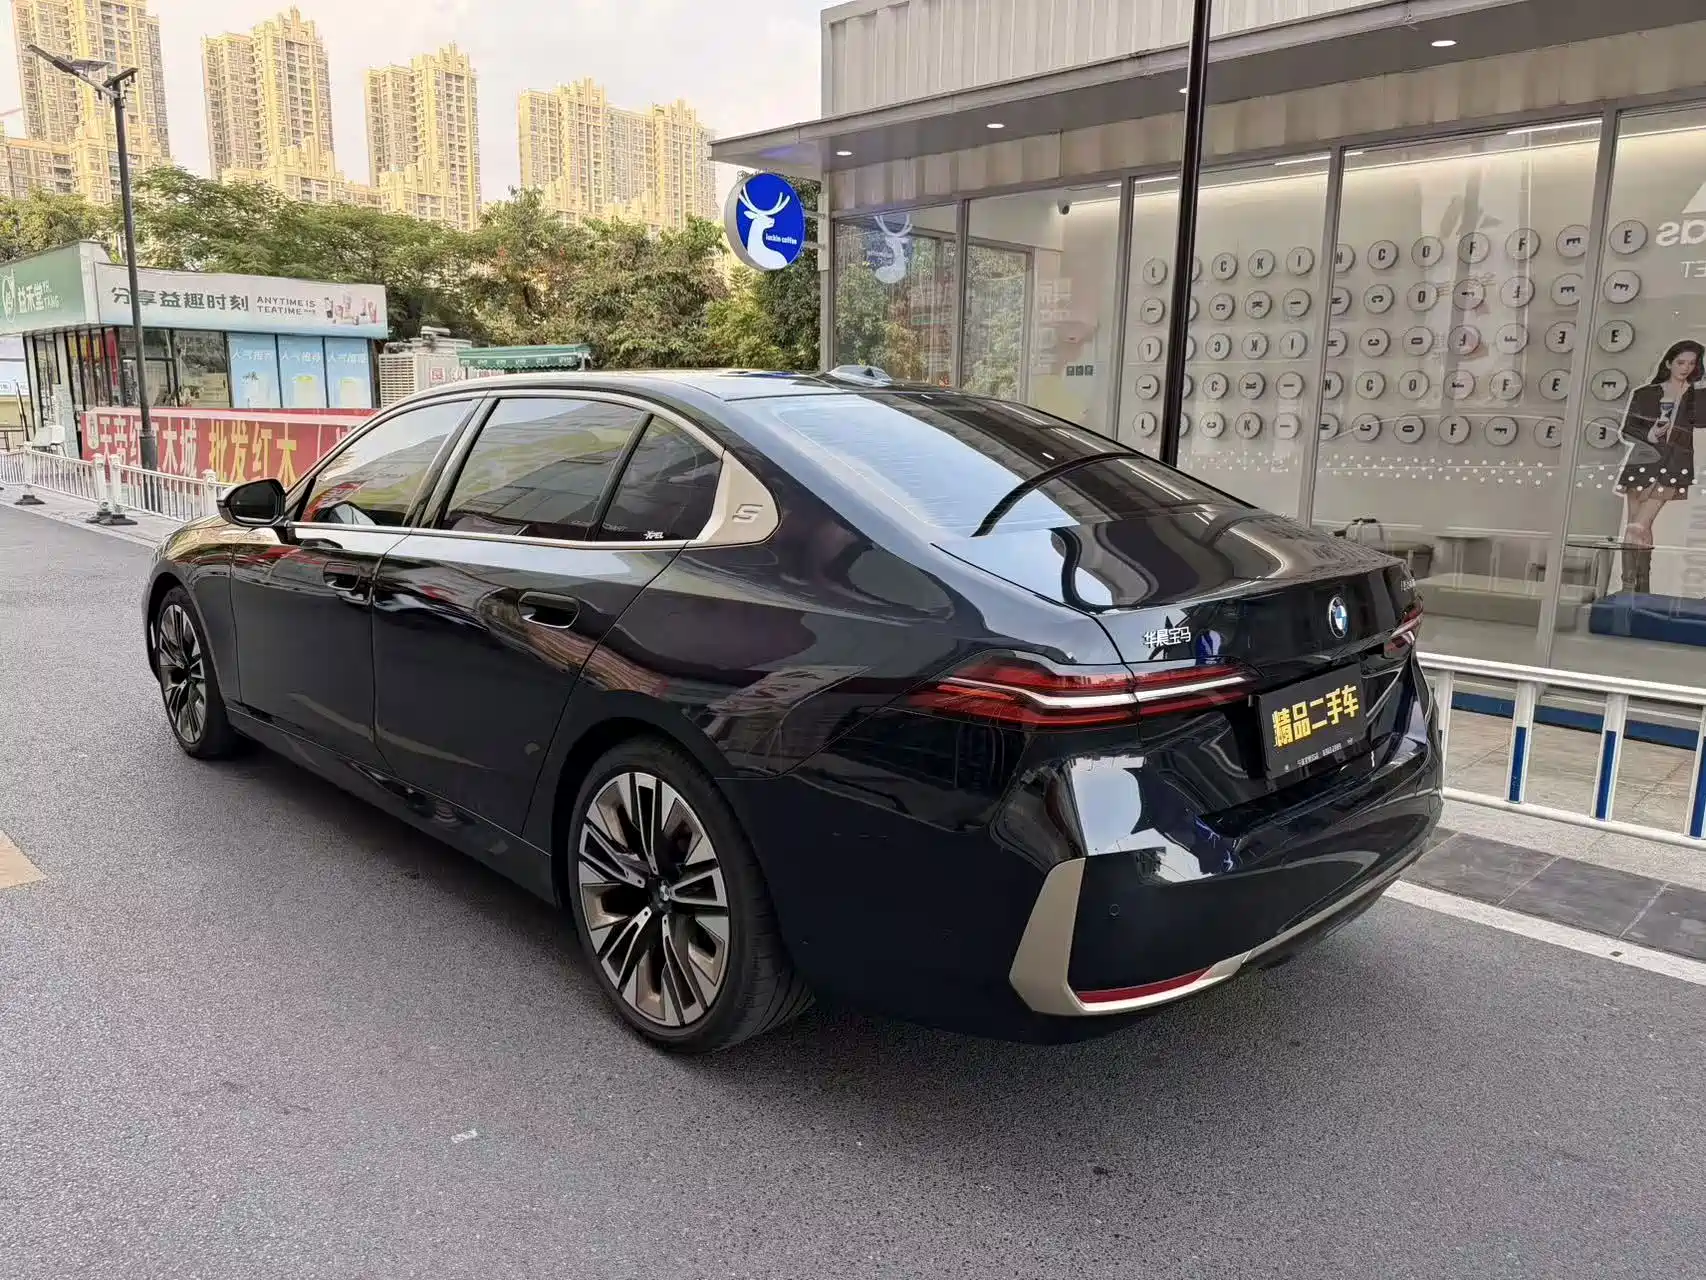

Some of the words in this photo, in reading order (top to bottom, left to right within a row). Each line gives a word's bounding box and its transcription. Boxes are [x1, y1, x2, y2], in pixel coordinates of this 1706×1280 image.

[111, 286, 249, 311] 分享益趣时刻
[257, 296, 304, 307] ANYTIME
[305, 300, 316, 308] IS
[257, 305, 303, 315] TEATIME
[643, 531, 664, 540] XPEL
[1144, 627, 1191, 646] 华晨宝马
[1272, 684, 1359, 747] 精品二手车
